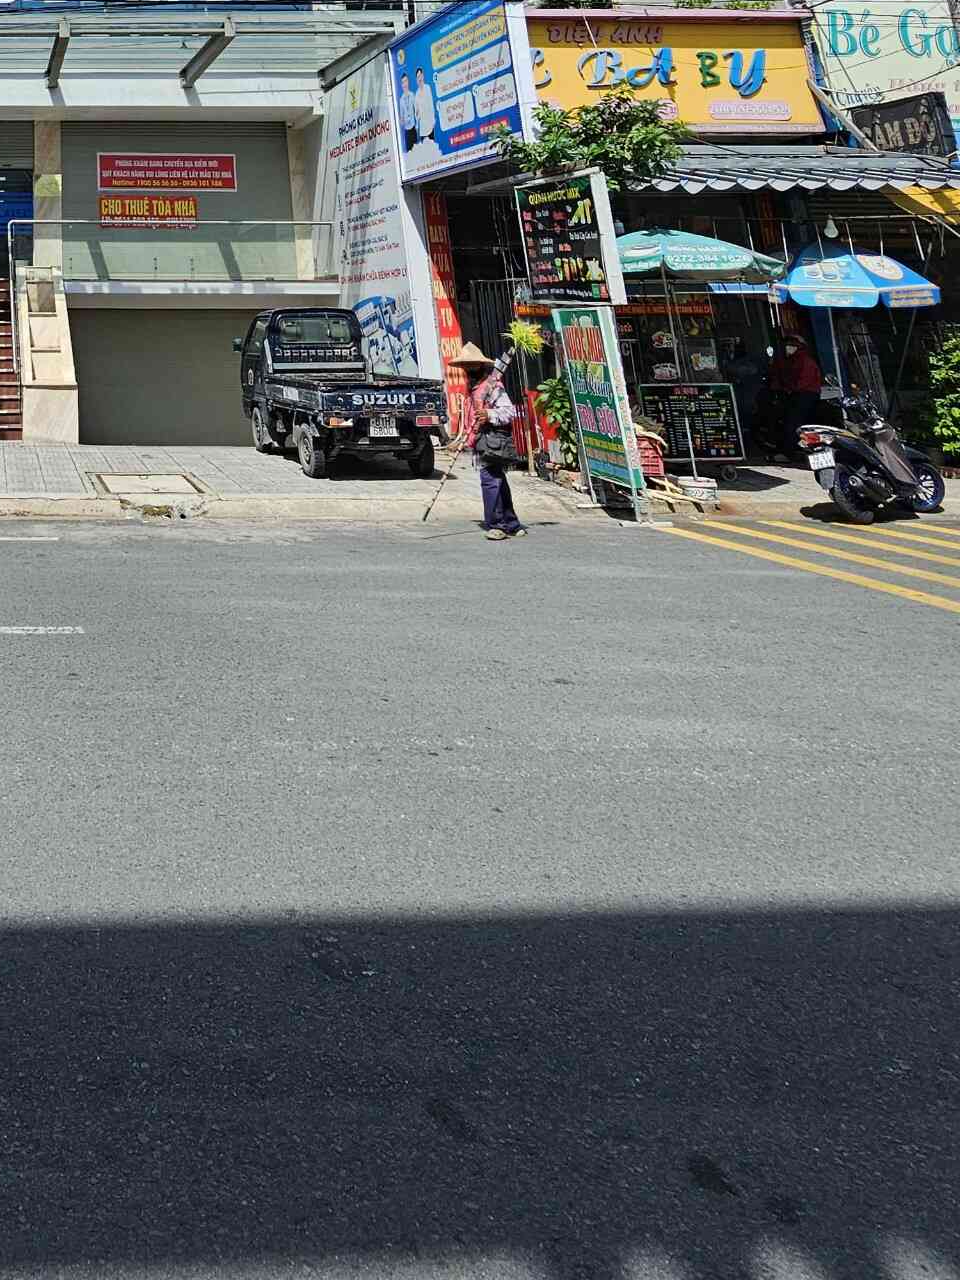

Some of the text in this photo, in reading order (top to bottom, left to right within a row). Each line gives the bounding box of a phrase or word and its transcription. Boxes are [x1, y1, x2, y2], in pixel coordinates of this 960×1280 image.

[824, 8, 882, 59] Bé
[101, 196, 196, 217] CHO THUÊ TÒA NHÀ
[351, 393, 416, 407] SUZUKI
